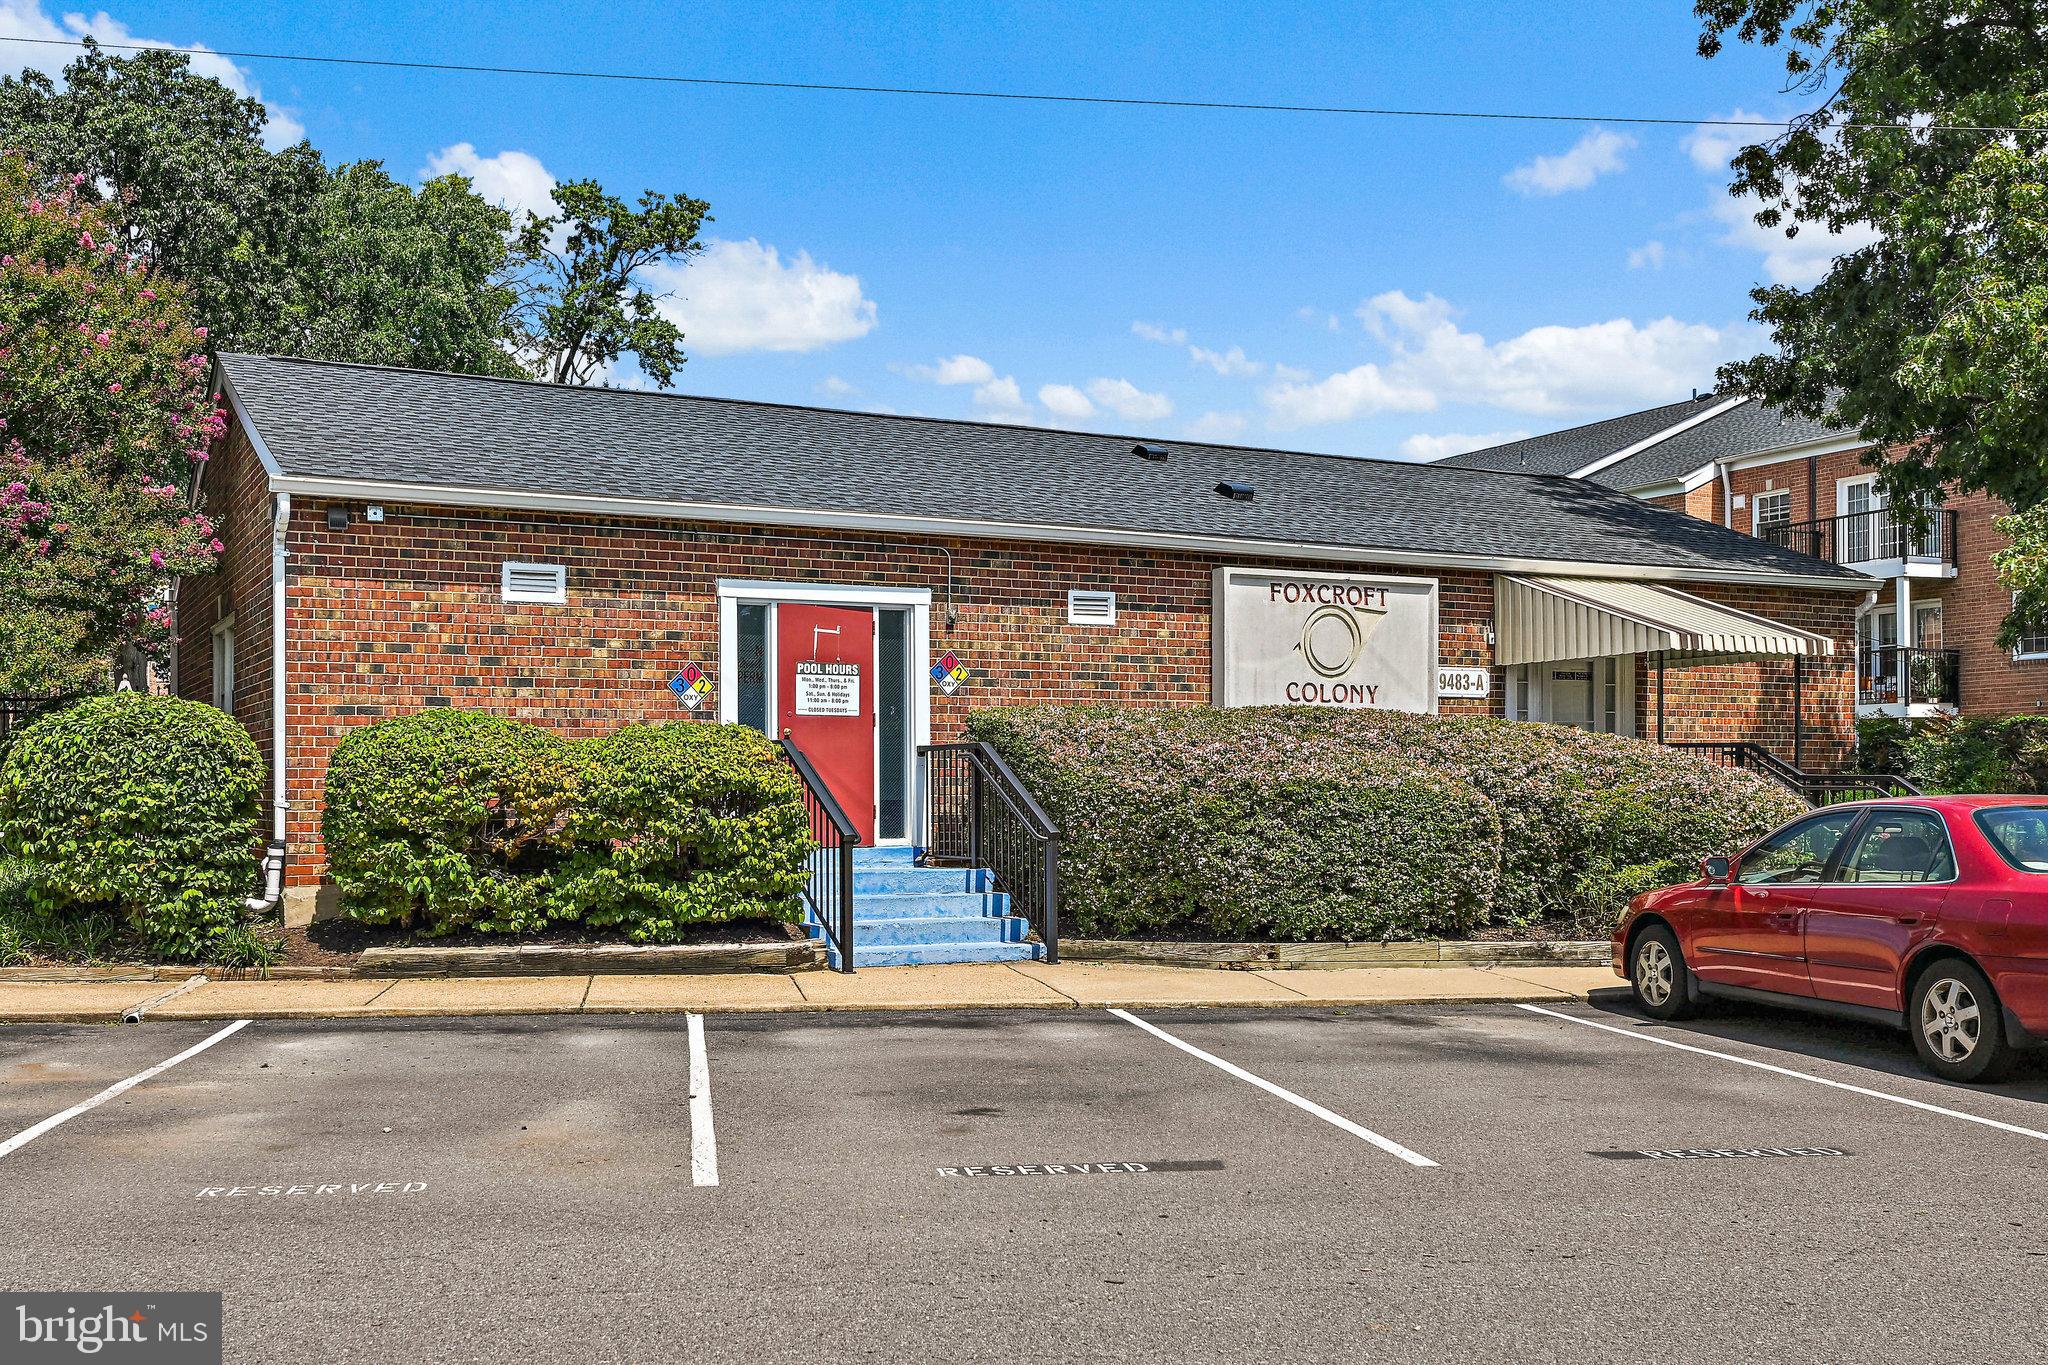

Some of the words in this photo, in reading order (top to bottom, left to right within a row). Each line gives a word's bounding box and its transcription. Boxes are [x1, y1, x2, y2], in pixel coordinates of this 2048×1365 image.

[1270, 582, 1389, 607] FOXCROFT
[797, 663, 823, 674] POOL
[825, 664, 859, 675] HOURS
[946, 656, 953, 669] 0
[687, 667, 696, 681] 0
[935, 666, 943, 679] 3
[956, 667, 962, 681] 2
[676, 678, 684, 692] 3
[699, 679, 706, 693] 2
[1439, 673, 1484, 691] 9483-A
[1286, 681, 1378, 704] COLONY
[937, 1162, 1149, 1177] RESERVED
[196, 1182, 428, 1198] RESERVED
